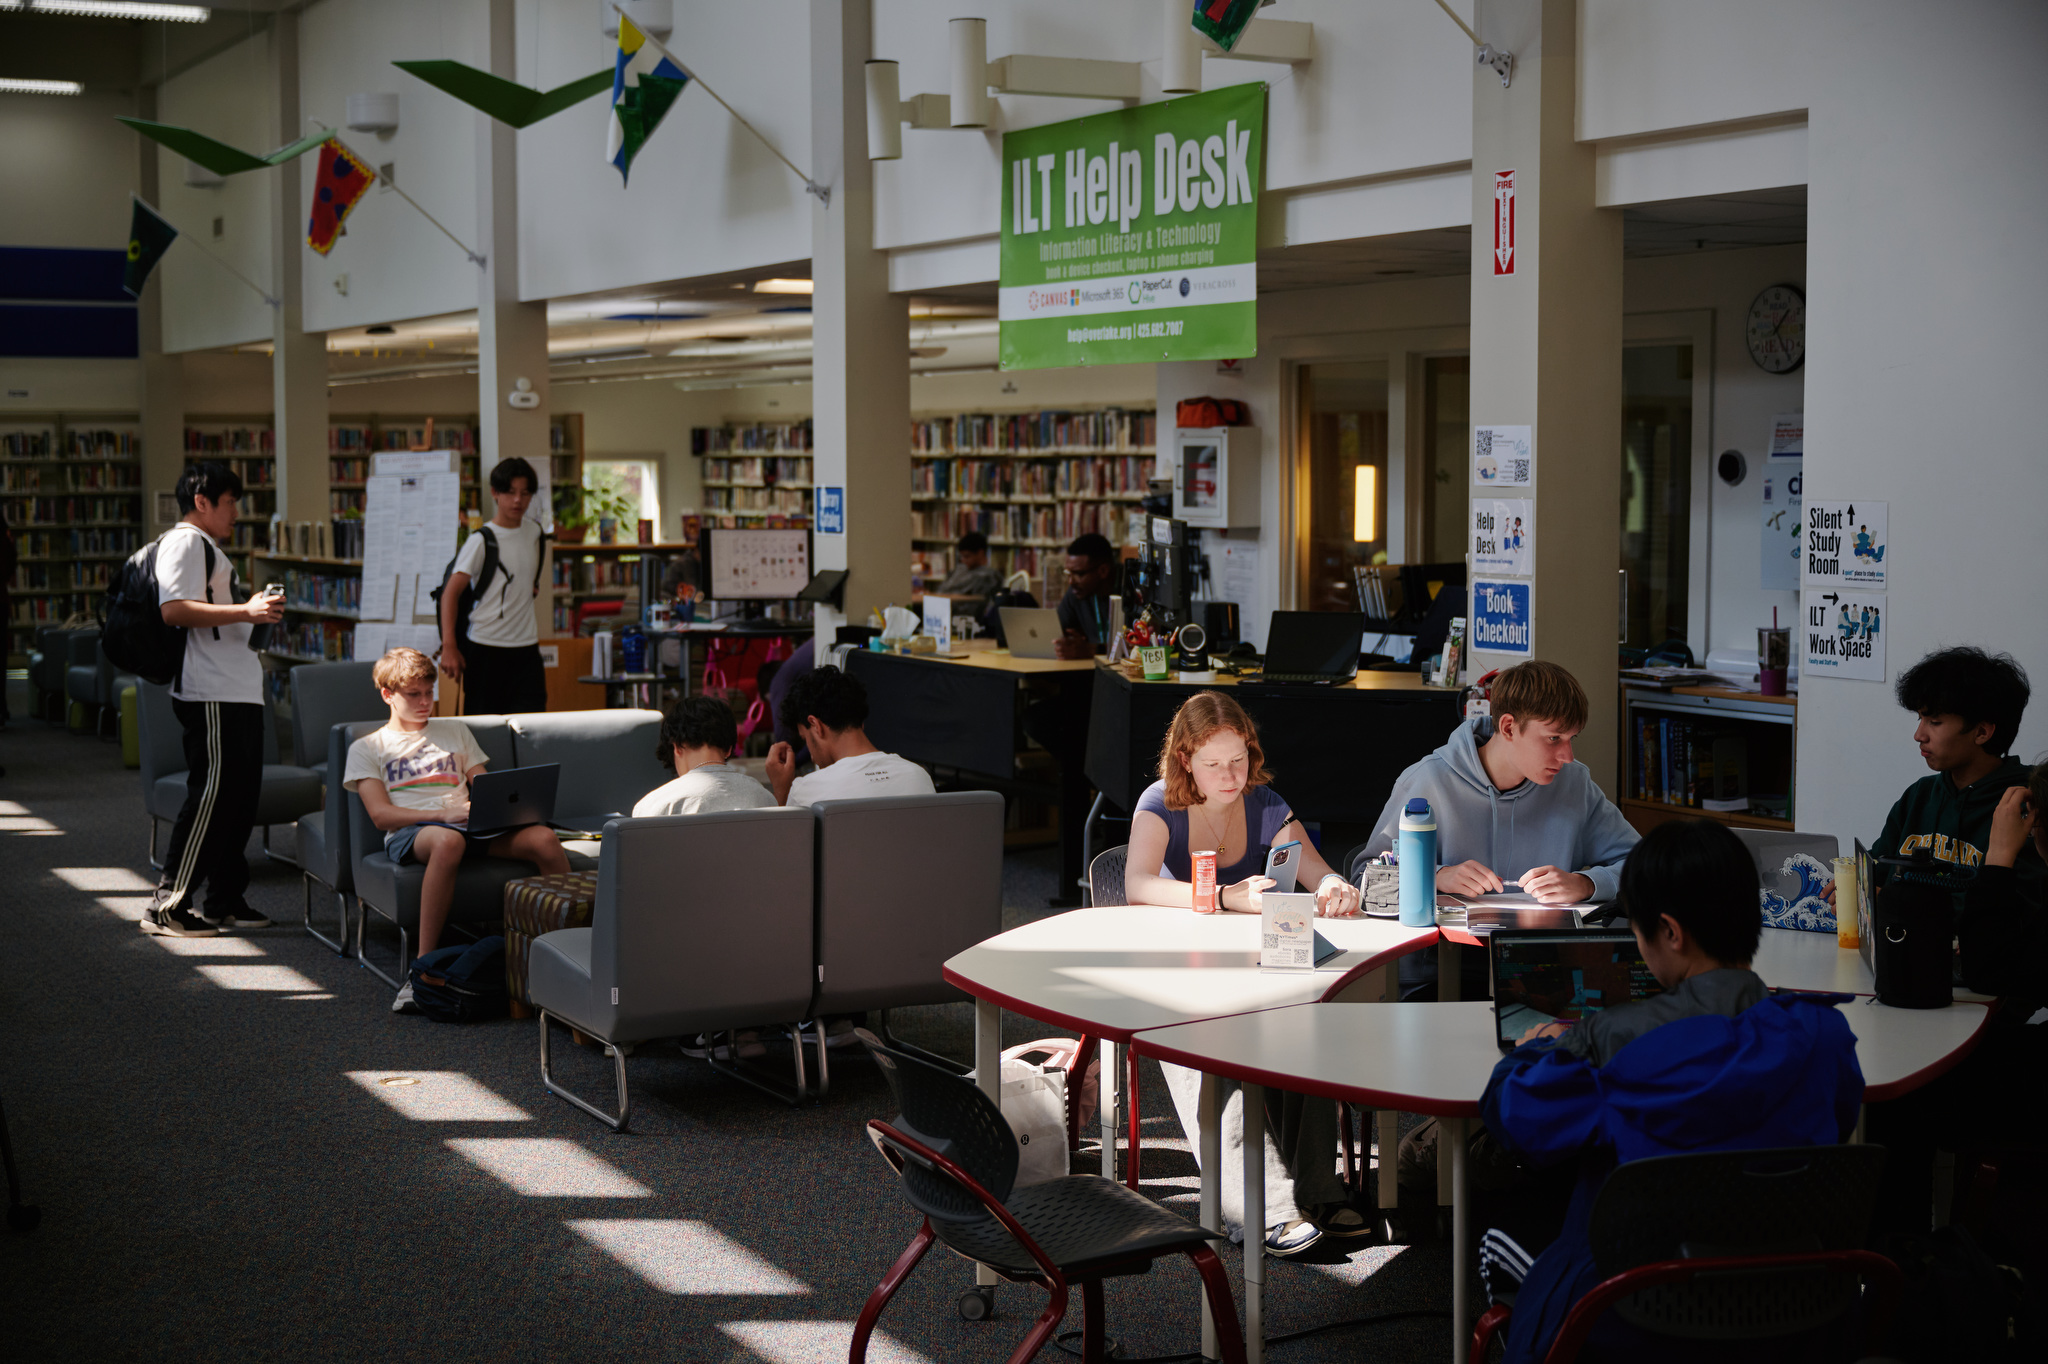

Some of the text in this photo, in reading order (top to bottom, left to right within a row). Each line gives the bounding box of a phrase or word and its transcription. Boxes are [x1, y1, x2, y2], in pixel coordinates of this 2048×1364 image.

[1013, 119, 1253, 235] ILT Help Desk
[1496, 180, 1512, 190] FIRE
[1040, 222, 1221, 262] Information Literacy & Technology
[1180, 248, 1214, 265] charging
[1040, 278, 1236, 308] CANVAS Microsoft 365 PaperCut VERACROSS
[1761, 339, 1794, 354] READ
[1476, 512, 1494, 534] Help
[1810, 508, 1842, 529] Silent
[1476, 536, 1495, 554] Desk
[1809, 530, 1841, 557] Study
[1809, 553, 1838, 575] Room
[1487, 588, 1513, 614] Book
[1810, 606, 1826, 626] ILT
[1476, 617, 1527, 645] Checkout
[1810, 633, 1871, 661] Work Space
